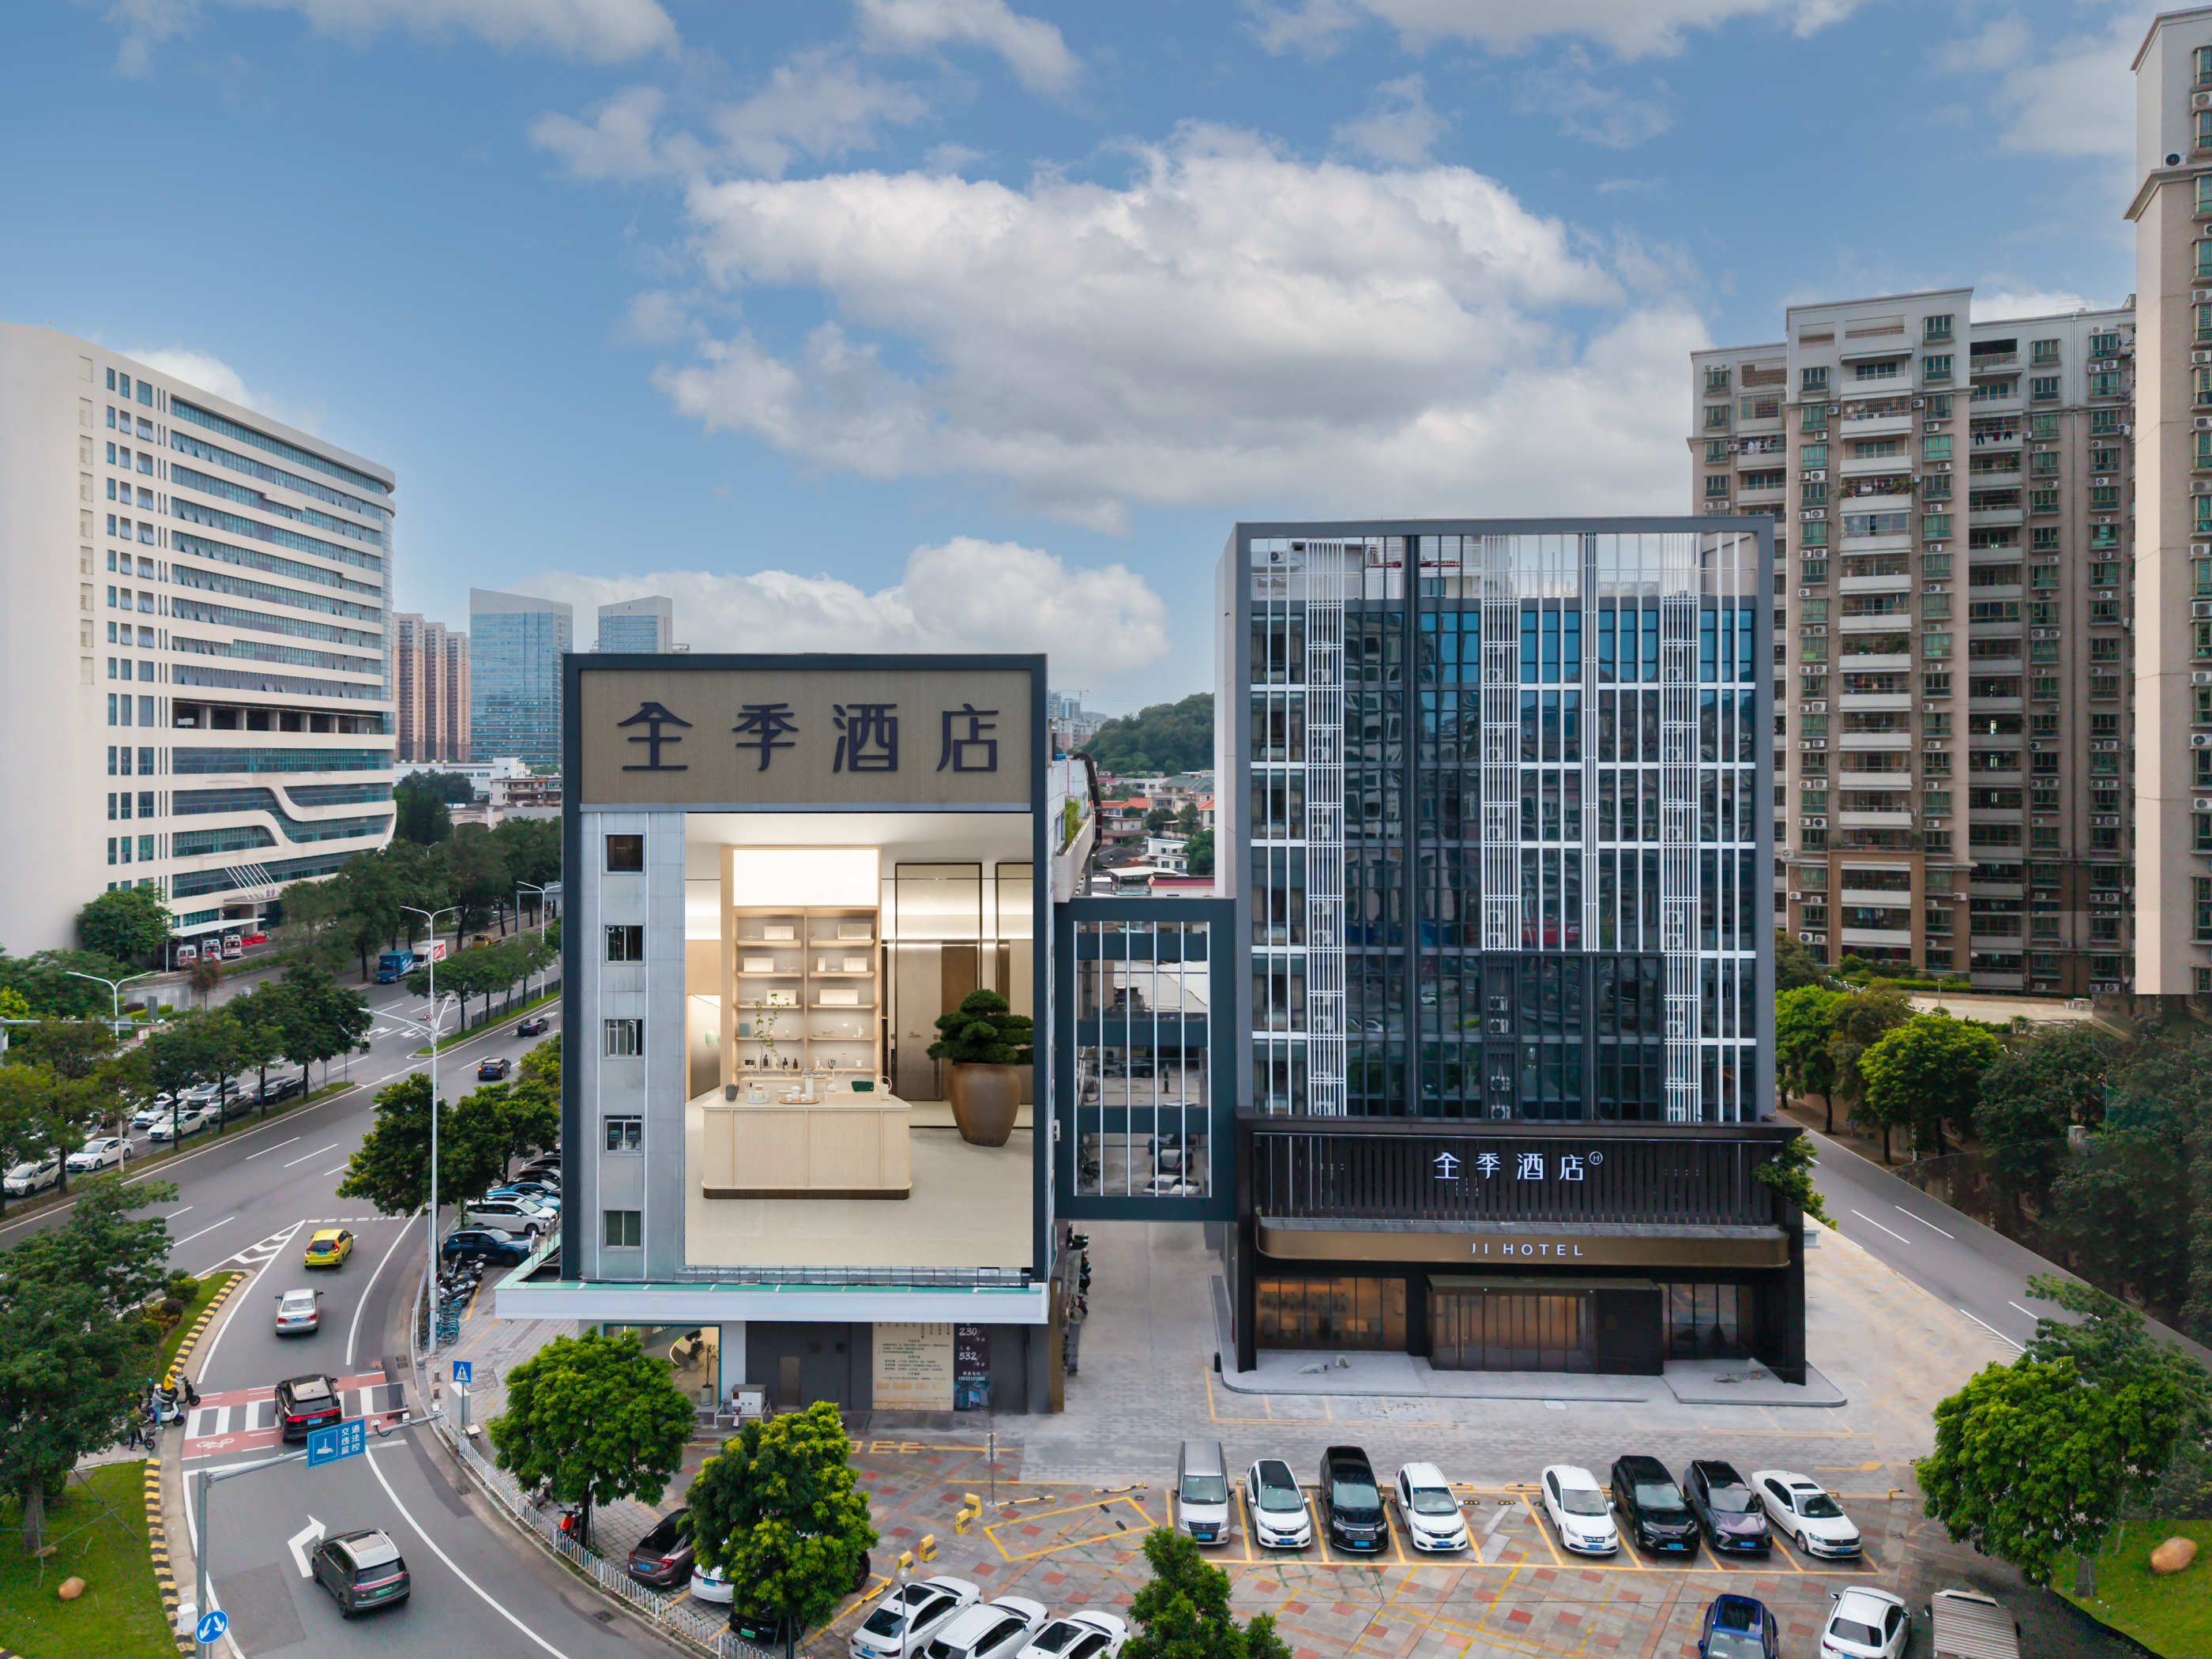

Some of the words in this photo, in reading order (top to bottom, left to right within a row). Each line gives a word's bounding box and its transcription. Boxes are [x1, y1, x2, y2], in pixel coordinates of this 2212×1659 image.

[617, 702, 999, 773] 全季酒店
[1432, 1152, 1584, 1181] 全季酒店
[1472, 1243, 1488, 1255] JI
[1503, 1243, 1584, 1256] HOTEL
